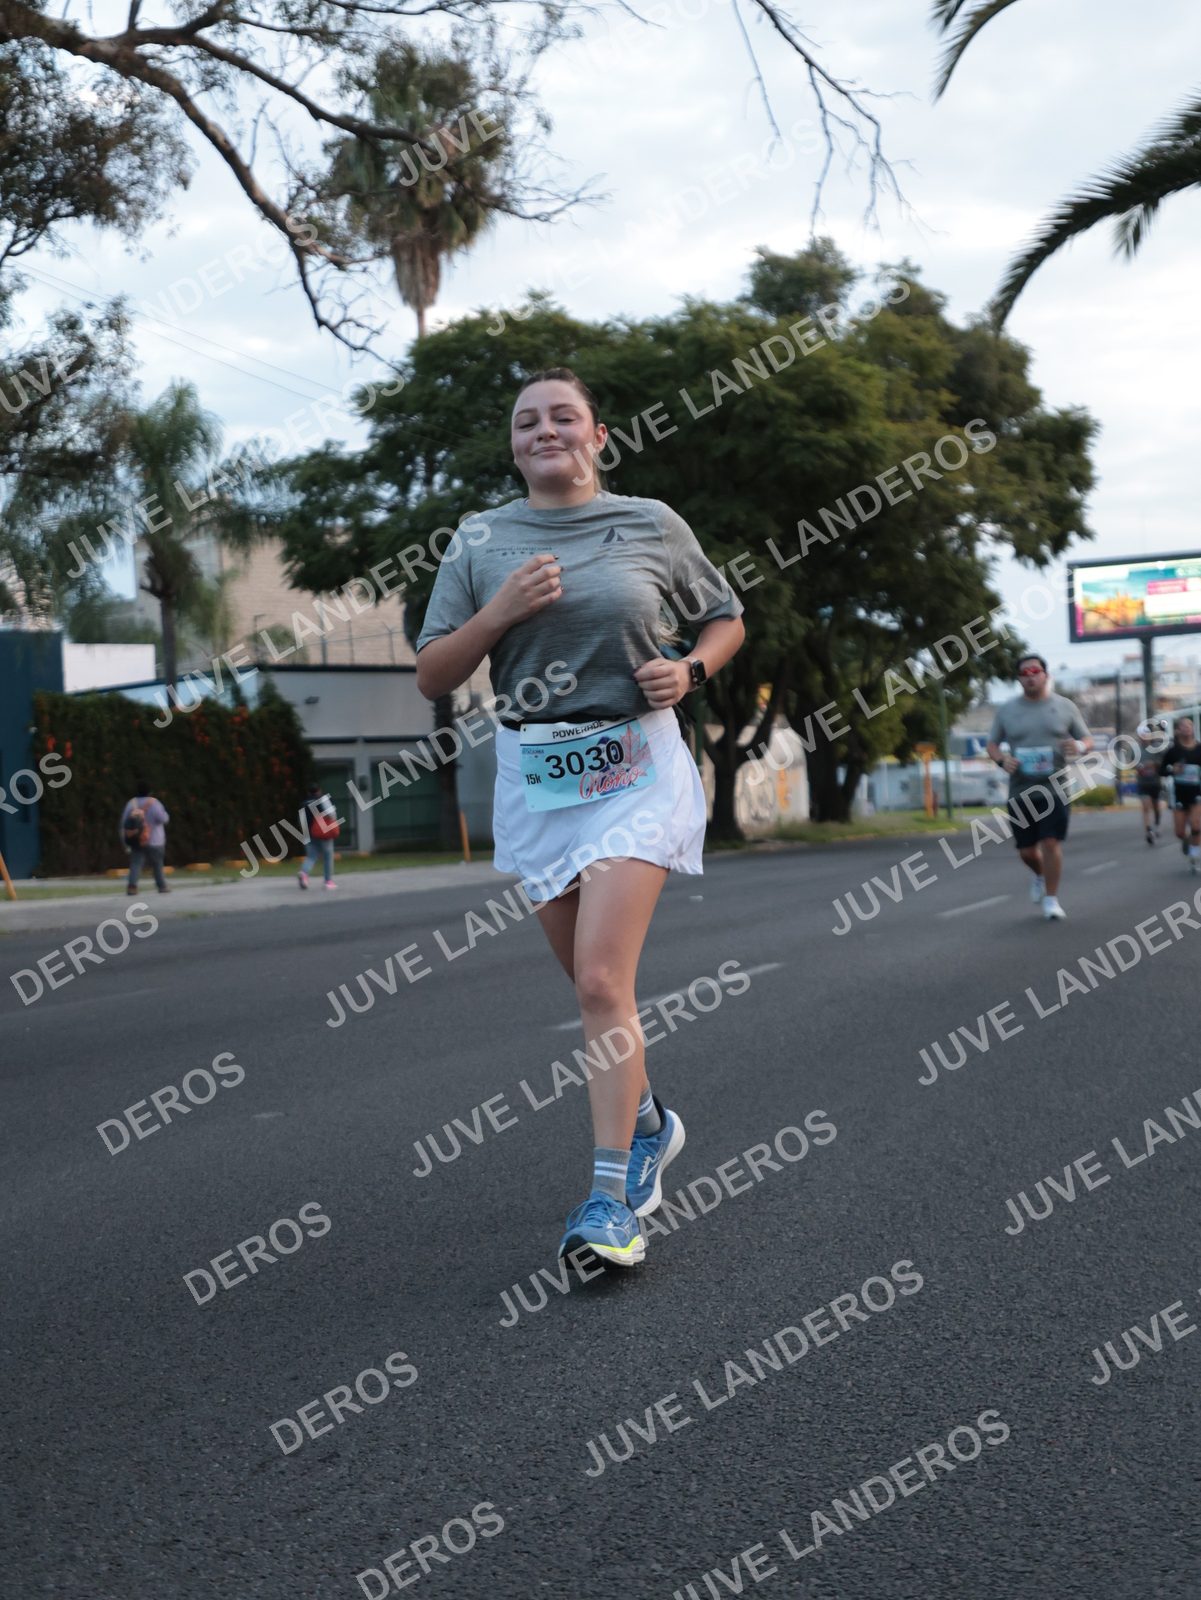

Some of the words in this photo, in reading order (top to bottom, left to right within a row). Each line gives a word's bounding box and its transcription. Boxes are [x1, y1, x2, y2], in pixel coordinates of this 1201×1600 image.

[552, 720, 605, 739] POWERADE
[544, 740, 624, 779] 3030
[525, 772, 542, 785] 15k
